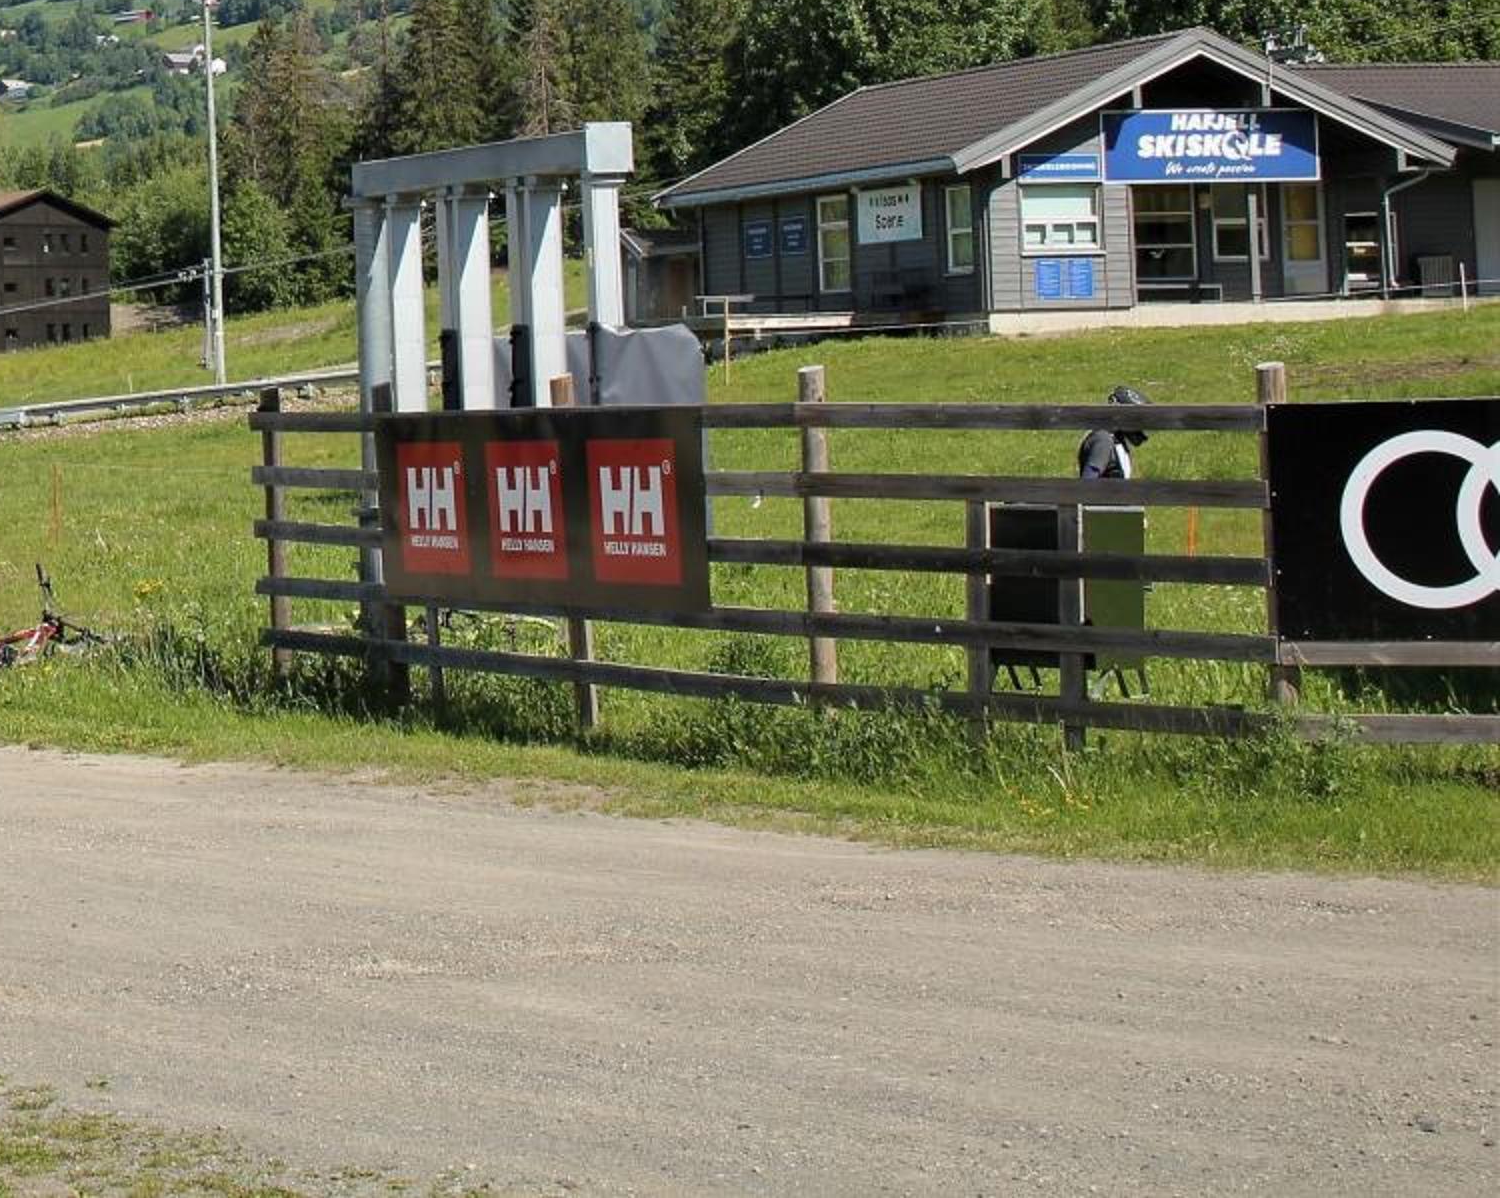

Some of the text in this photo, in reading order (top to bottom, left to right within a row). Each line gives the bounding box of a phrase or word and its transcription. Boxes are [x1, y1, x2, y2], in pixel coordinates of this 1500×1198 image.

[1171, 113, 1260, 131] HAFJELL
[407, 466, 457, 530] HH
[496, 465, 553, 533] HH
[599, 465, 665, 536] HH
